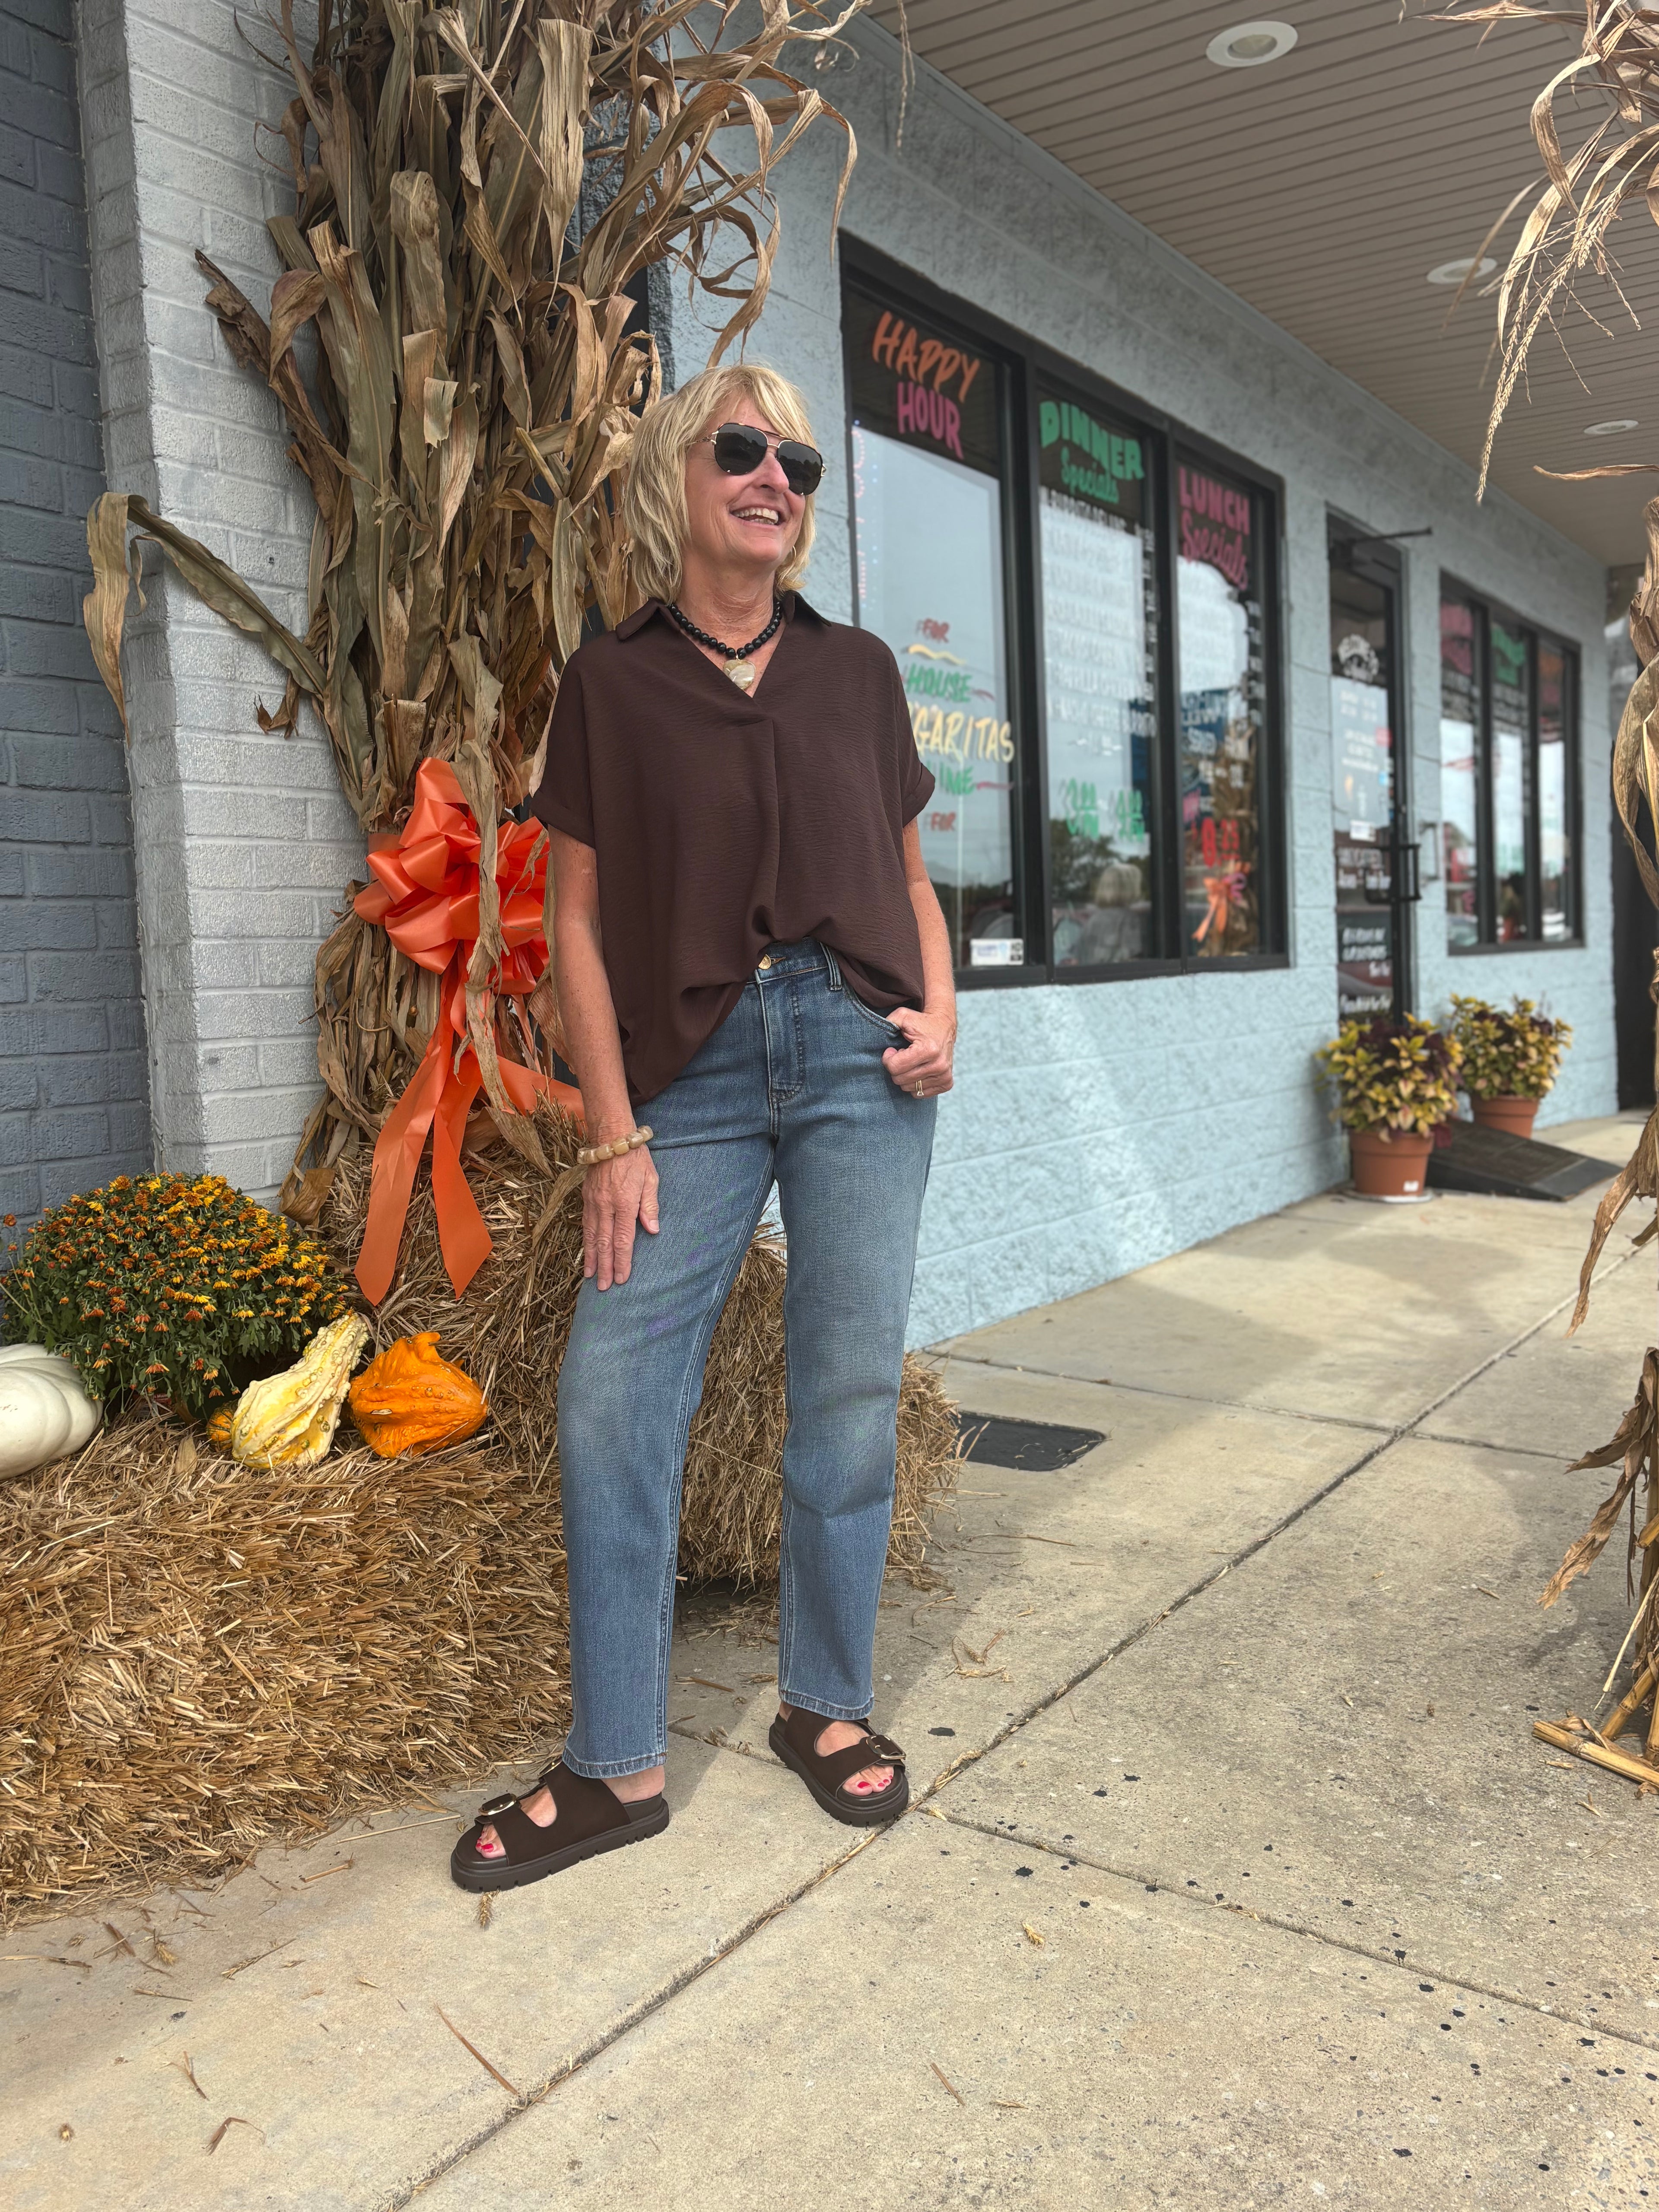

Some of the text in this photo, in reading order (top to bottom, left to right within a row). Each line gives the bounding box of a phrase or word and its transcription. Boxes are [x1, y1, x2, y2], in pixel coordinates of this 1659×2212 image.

[872, 311, 981, 403] HAPPY
[896, 381, 964, 460] HOUR
[1039, 400, 1144, 480] DINNER
[1179, 467, 1250, 535] LUNCH
[907, 663, 973, 702] HOUSE
[907, 701, 1014, 763] GARITAS
